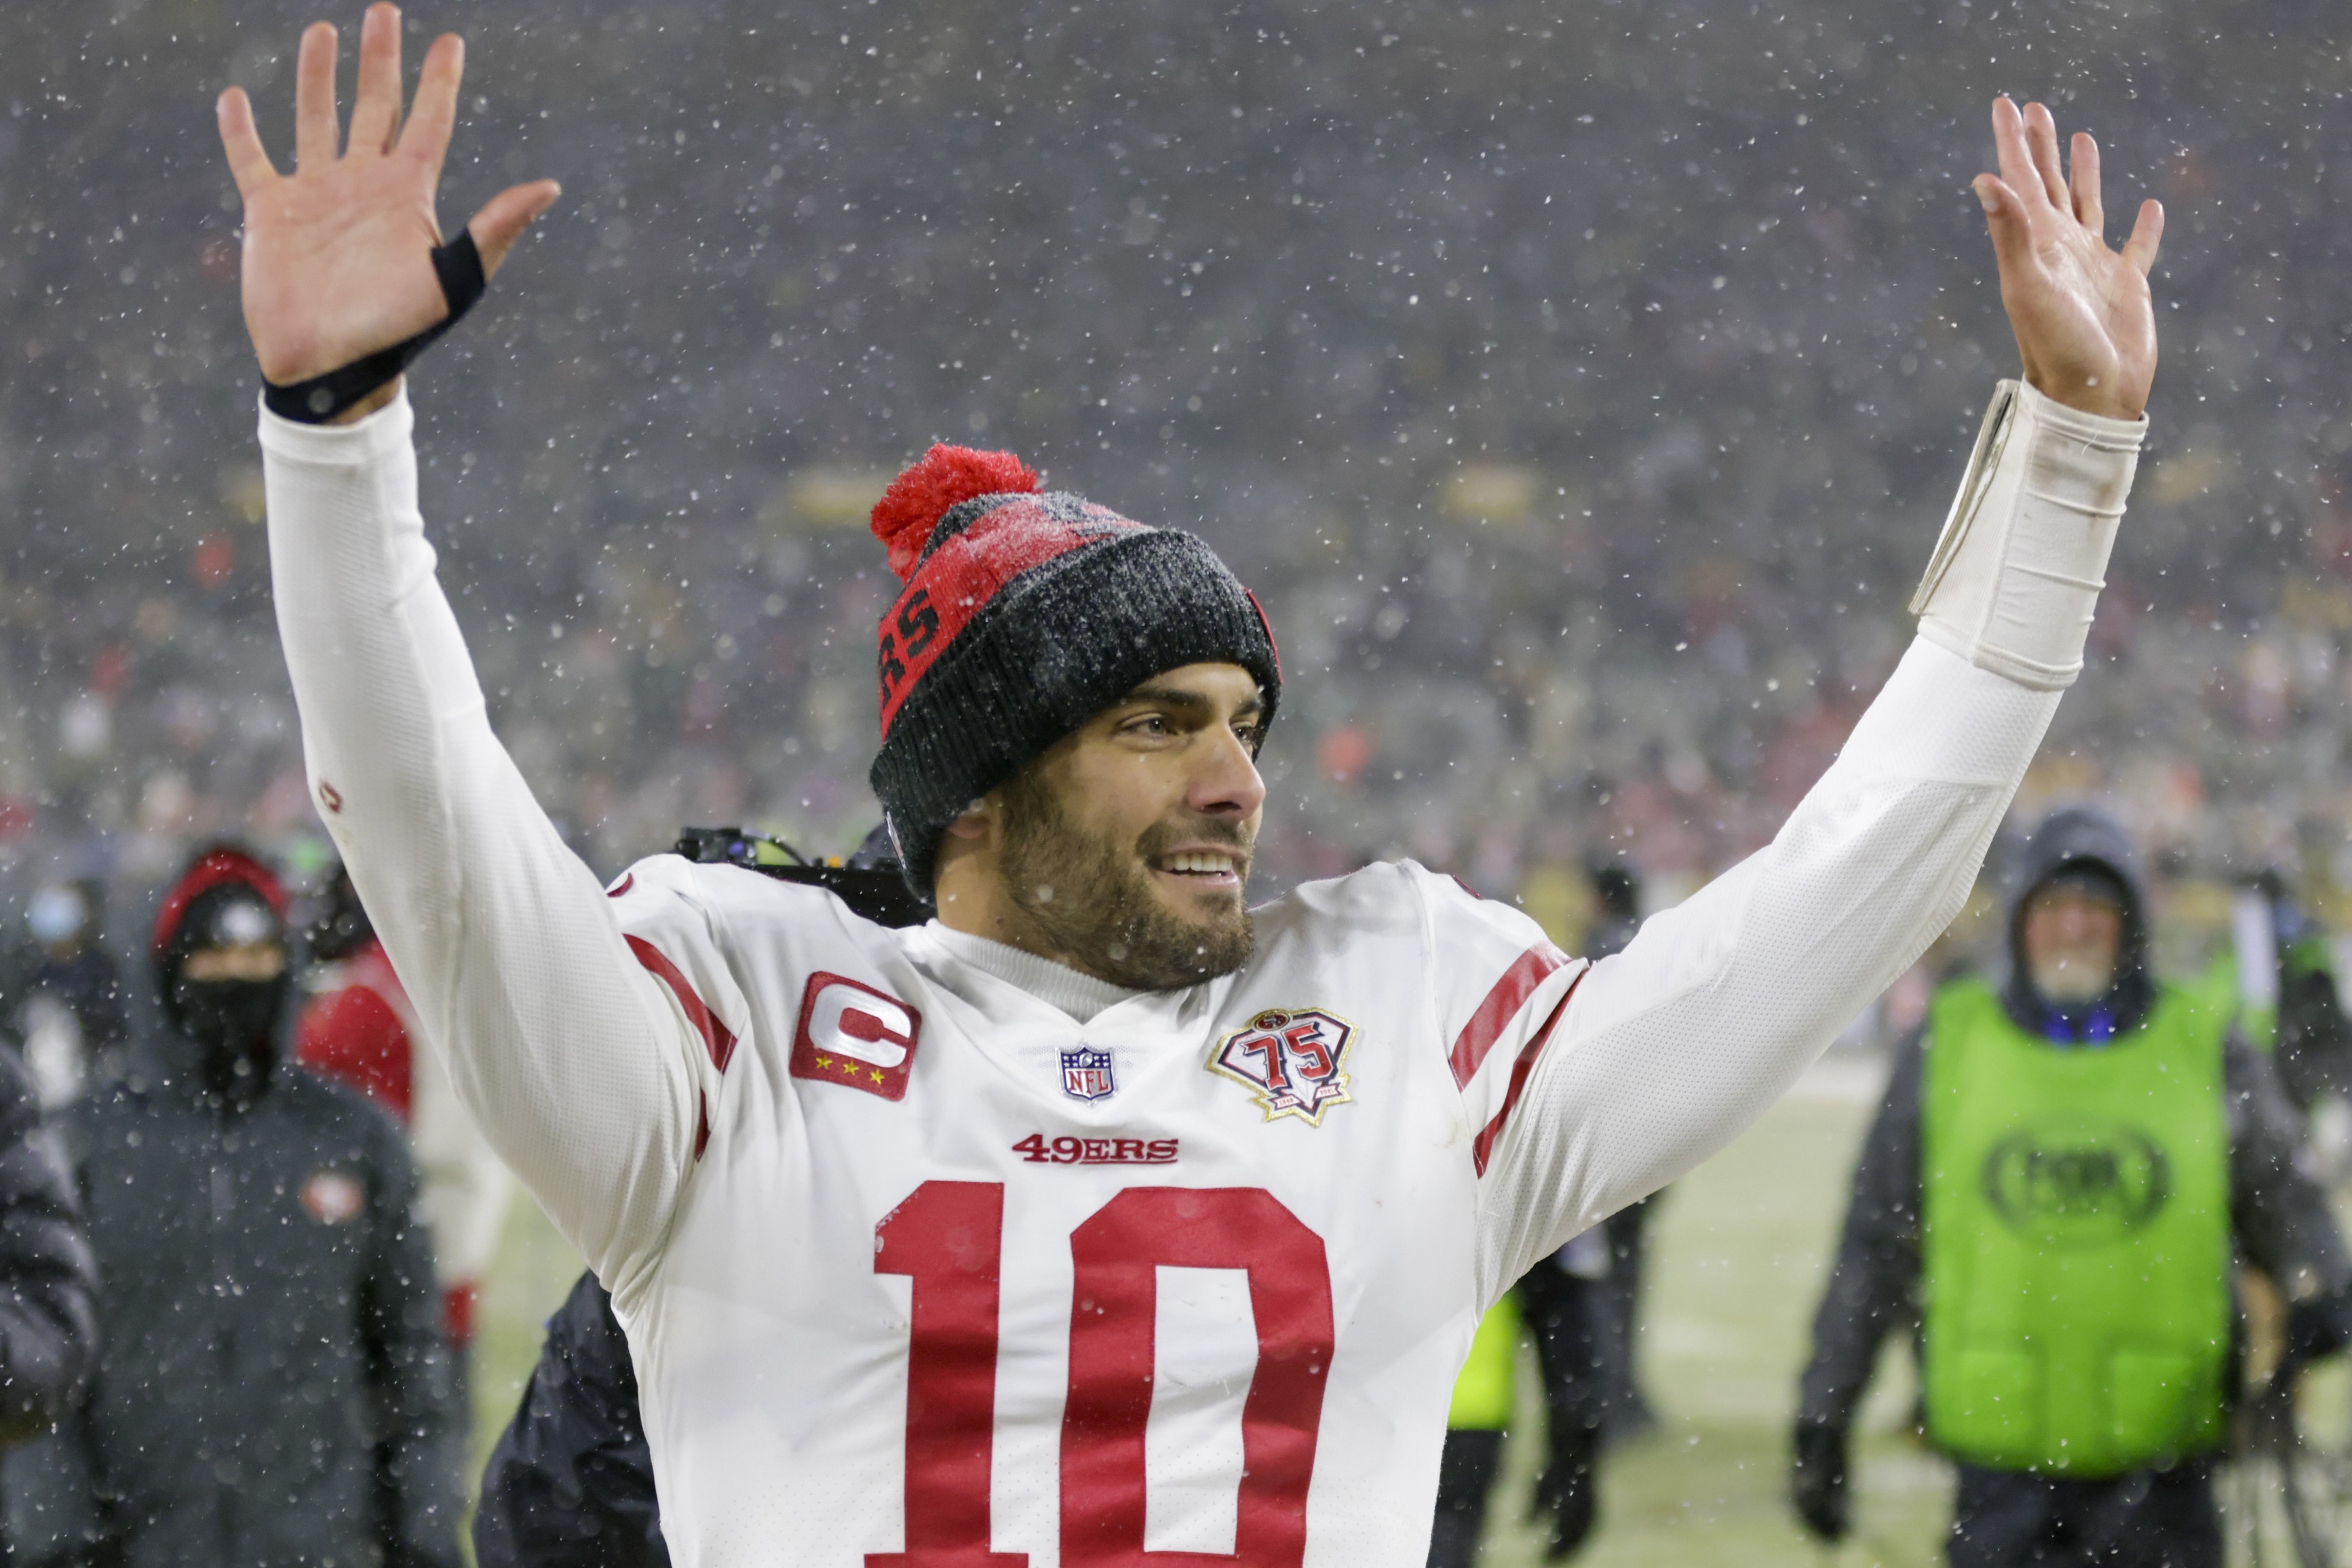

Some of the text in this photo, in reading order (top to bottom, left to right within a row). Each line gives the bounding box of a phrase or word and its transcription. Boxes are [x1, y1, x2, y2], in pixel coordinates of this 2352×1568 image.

[807, 983, 912, 1068] C
[1239, 1022, 1335, 1091] 75
[1068, 1070, 1109, 1095] NFL
[1011, 1133, 1179, 1164] 49ERS
[864, 1179, 1335, 1568] 10
